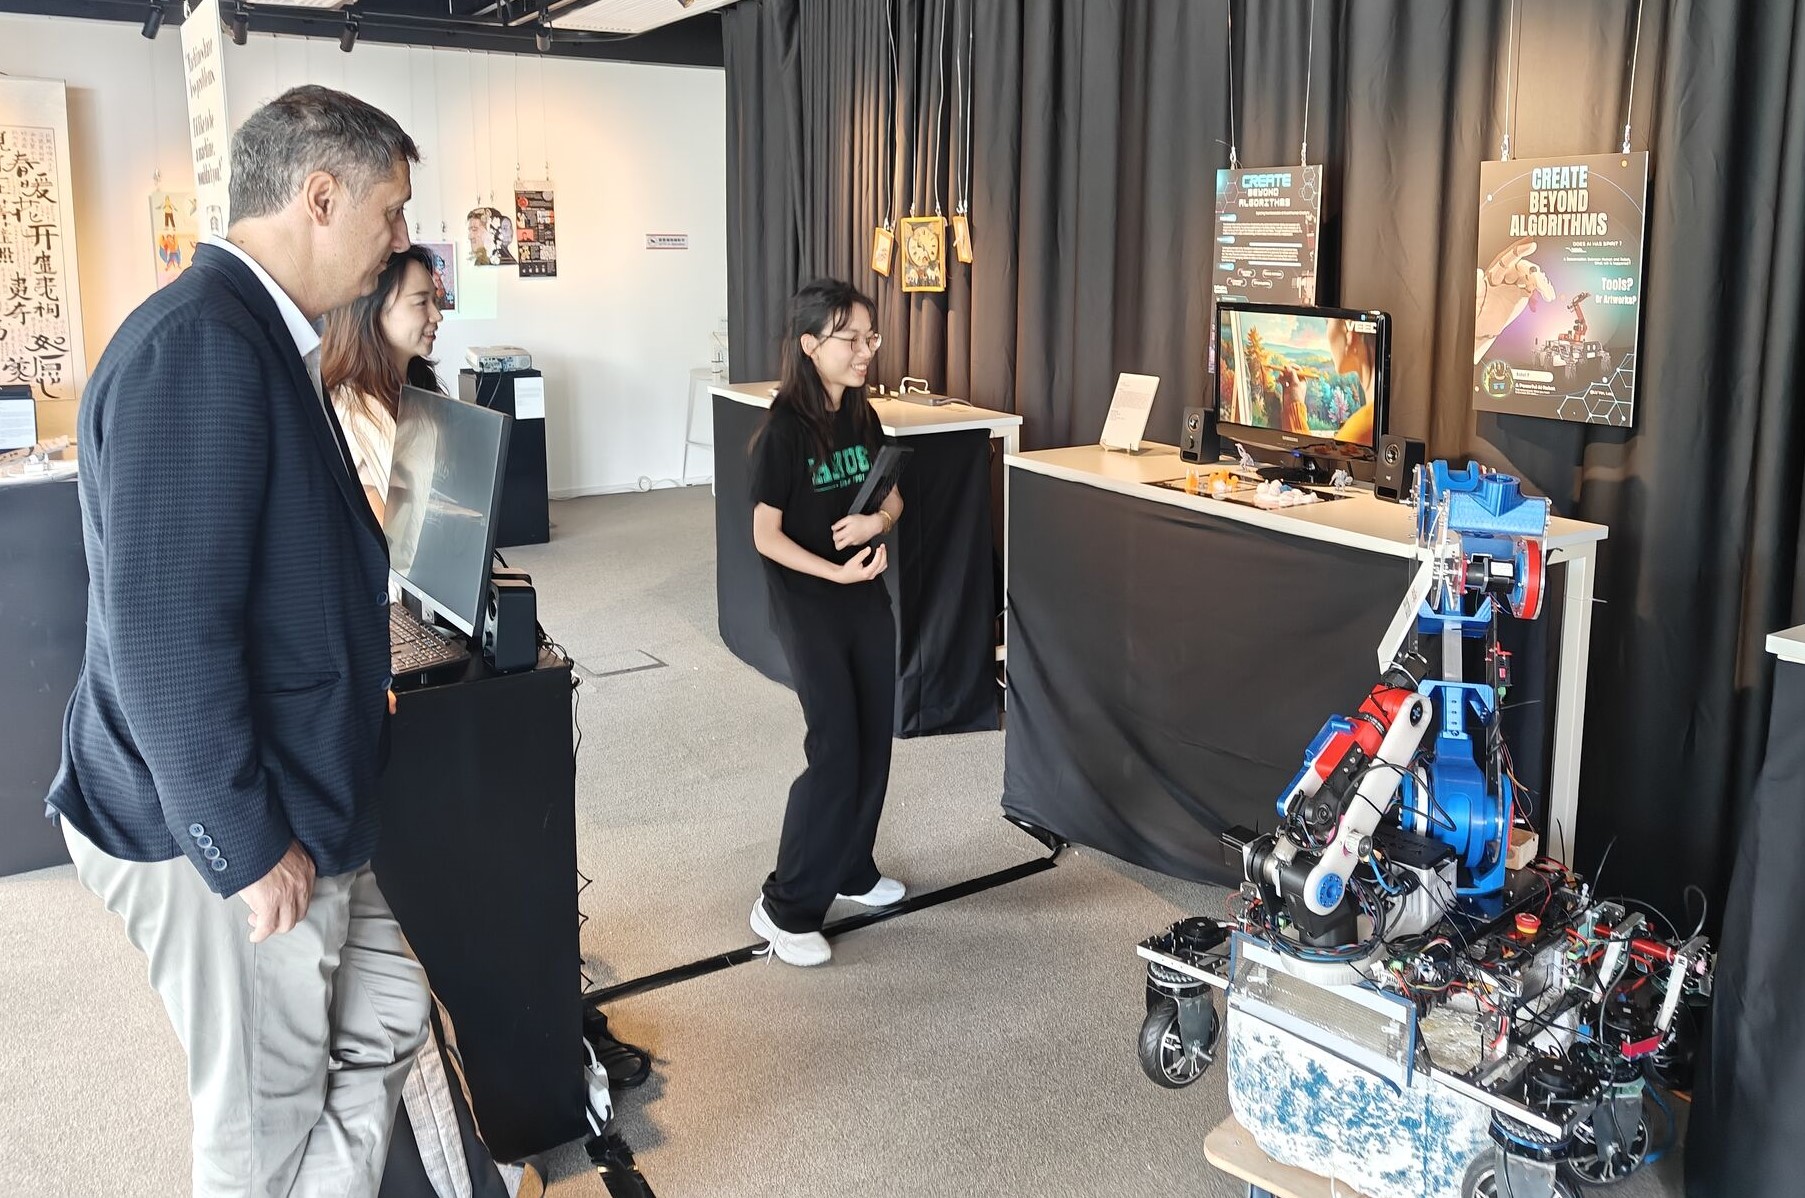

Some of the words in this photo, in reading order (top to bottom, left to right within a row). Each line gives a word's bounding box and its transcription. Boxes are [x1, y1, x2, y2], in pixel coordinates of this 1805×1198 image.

[1242, 173, 1291, 188] CREATE
[1532, 165, 1588, 190] CREATE
[1248, 188, 1279, 197] BEYOND
[1239, 198, 1290, 208] ALGORITHMS
[1529, 189, 1588, 213] BEYOND
[1510, 213, 1608, 237] ALGORITHMS
[1601, 276, 1634, 292] Tools?
[1596, 295, 1602, 304] Or
[1603, 295, 1637, 305] Artworks?
